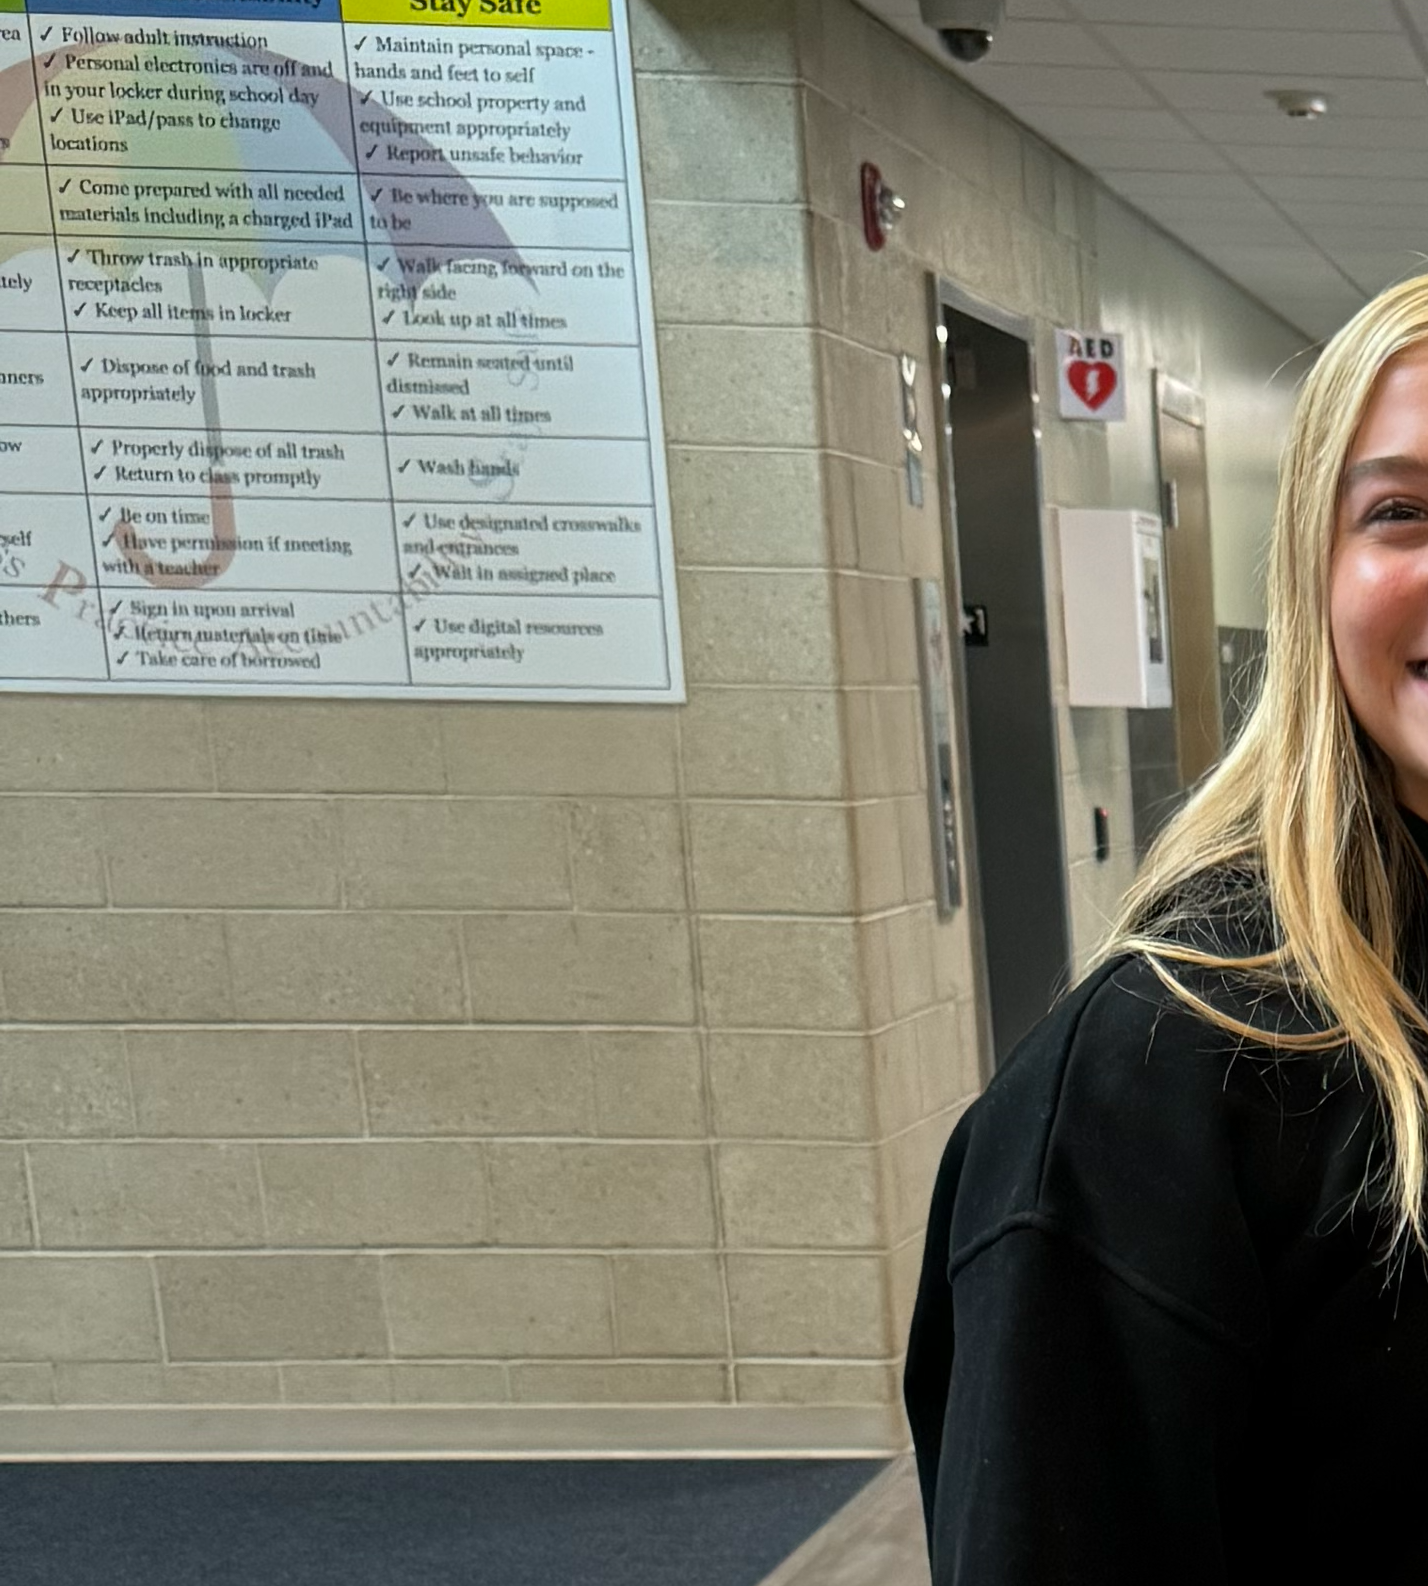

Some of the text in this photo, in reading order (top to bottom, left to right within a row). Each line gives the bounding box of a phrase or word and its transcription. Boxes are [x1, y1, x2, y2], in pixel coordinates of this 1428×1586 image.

[0, 29, 21, 41] ea
[62, 27, 267, 48] Follow adult instruction
[376, 36, 452, 53] Maintain
[459, 41, 531, 59] personal
[536, 44, 583, 60] space
[65, 53, 333, 78] Personal electronics are off and
[355, 62, 535, 82] hands and feet to self
[45, 80, 318, 107] in your locker during school day
[381, 91, 585, 115] Use school property and
[72, 109, 281, 132] Use iPad/pass to change
[360, 120, 570, 141] equipment appropriately
[51, 135, 128, 152] locations
[387, 146, 583, 165] Report unsafe behavior
[80, 180, 345, 201] Come prepared with all needed
[392, 188, 618, 211] Be where you are supposed
[60, 207, 352, 231] materials including a charged iPad
[370, 214, 411, 230] to be
[87, 250, 318, 272] Throw trash in appropriate
[398, 259, 624, 278] Walk facing forward on the
[0, 274, 32, 292] tely
[69, 277, 163, 294] receptacles
[377, 285, 456, 300] right side
[96, 303, 291, 322] Keep all items in locker
[404, 305, 568, 329] Look up at all times
[1069, 336, 1114, 358] AED
[102, 358, 315, 379] Dispose of food and trash
[408, 354, 573, 372] Remain seated until
[81, 386, 196, 404] appropriately
[386, 380, 470, 395] dismissed
[413, 405, 551, 423] Walk at all times
[113, 440, 344, 461] Properly dispose of all trash
[115, 466, 321, 488] Return to class promptly
[420, 460, 519, 476] Wash hands
[121, 508, 209, 524] Be on time
[424, 514, 641, 533] Use designated crosswalks
[124, 535, 352, 556] Have permission if meeting
[403, 541, 519, 556] and entrances
[102, 560, 220, 576] with a teacher
[435, 567, 616, 585] Wait in assigned place
[0, 611, 40, 626] hers
[131, 602, 295, 619] Sign in upon arrival
[135, 628, 342, 645] Return materials on time
[435, 619, 603, 637] Use digital resources
[137, 652, 320, 669] Take care of borrowed
[415, 645, 524, 662] appropriately
